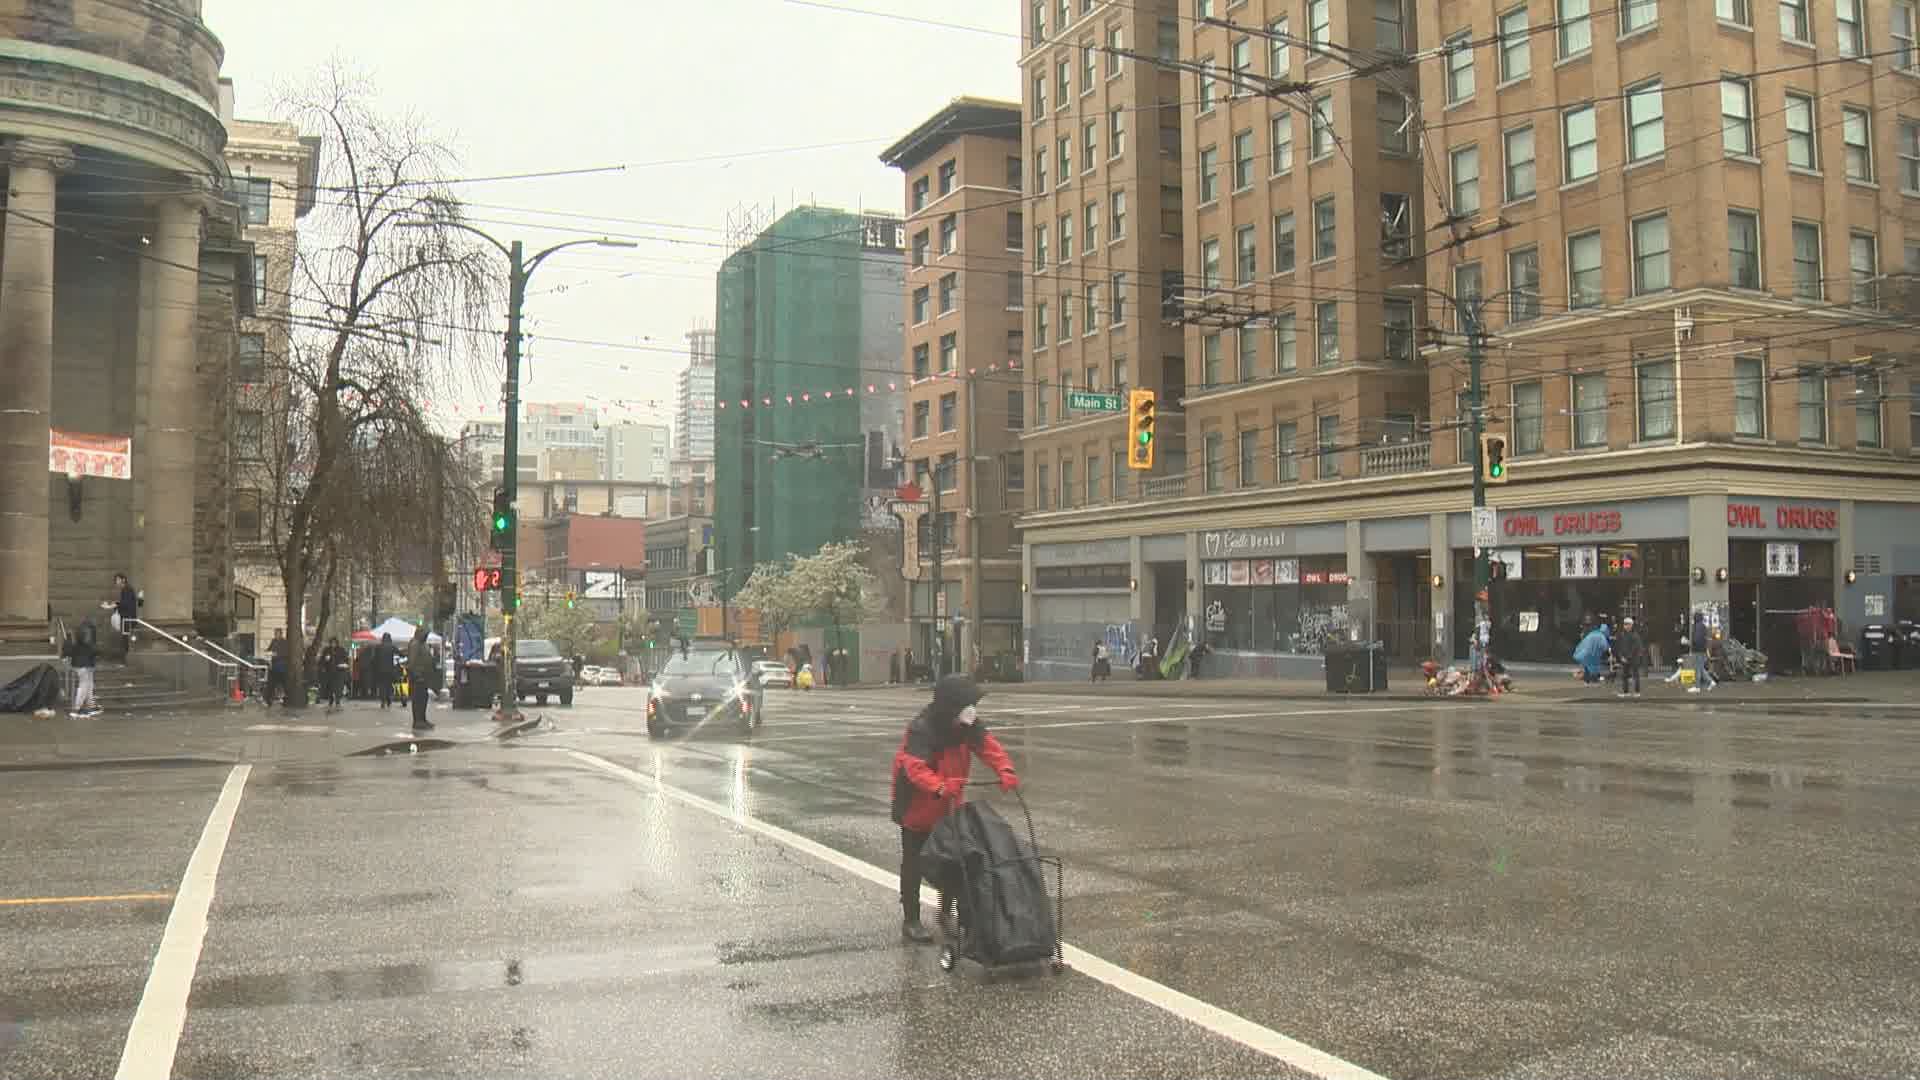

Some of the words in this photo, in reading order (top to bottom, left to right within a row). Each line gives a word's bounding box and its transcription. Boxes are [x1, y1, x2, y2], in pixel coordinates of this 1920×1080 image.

[1074, 396, 1101, 409] Main
[1104, 398, 1118, 410] St
[1503, 514, 1545, 537] OWL
[1553, 511, 1623, 535] DRUGS
[1728, 504, 1767, 529] OWL
[1776, 505, 1838, 530] DRUGS
